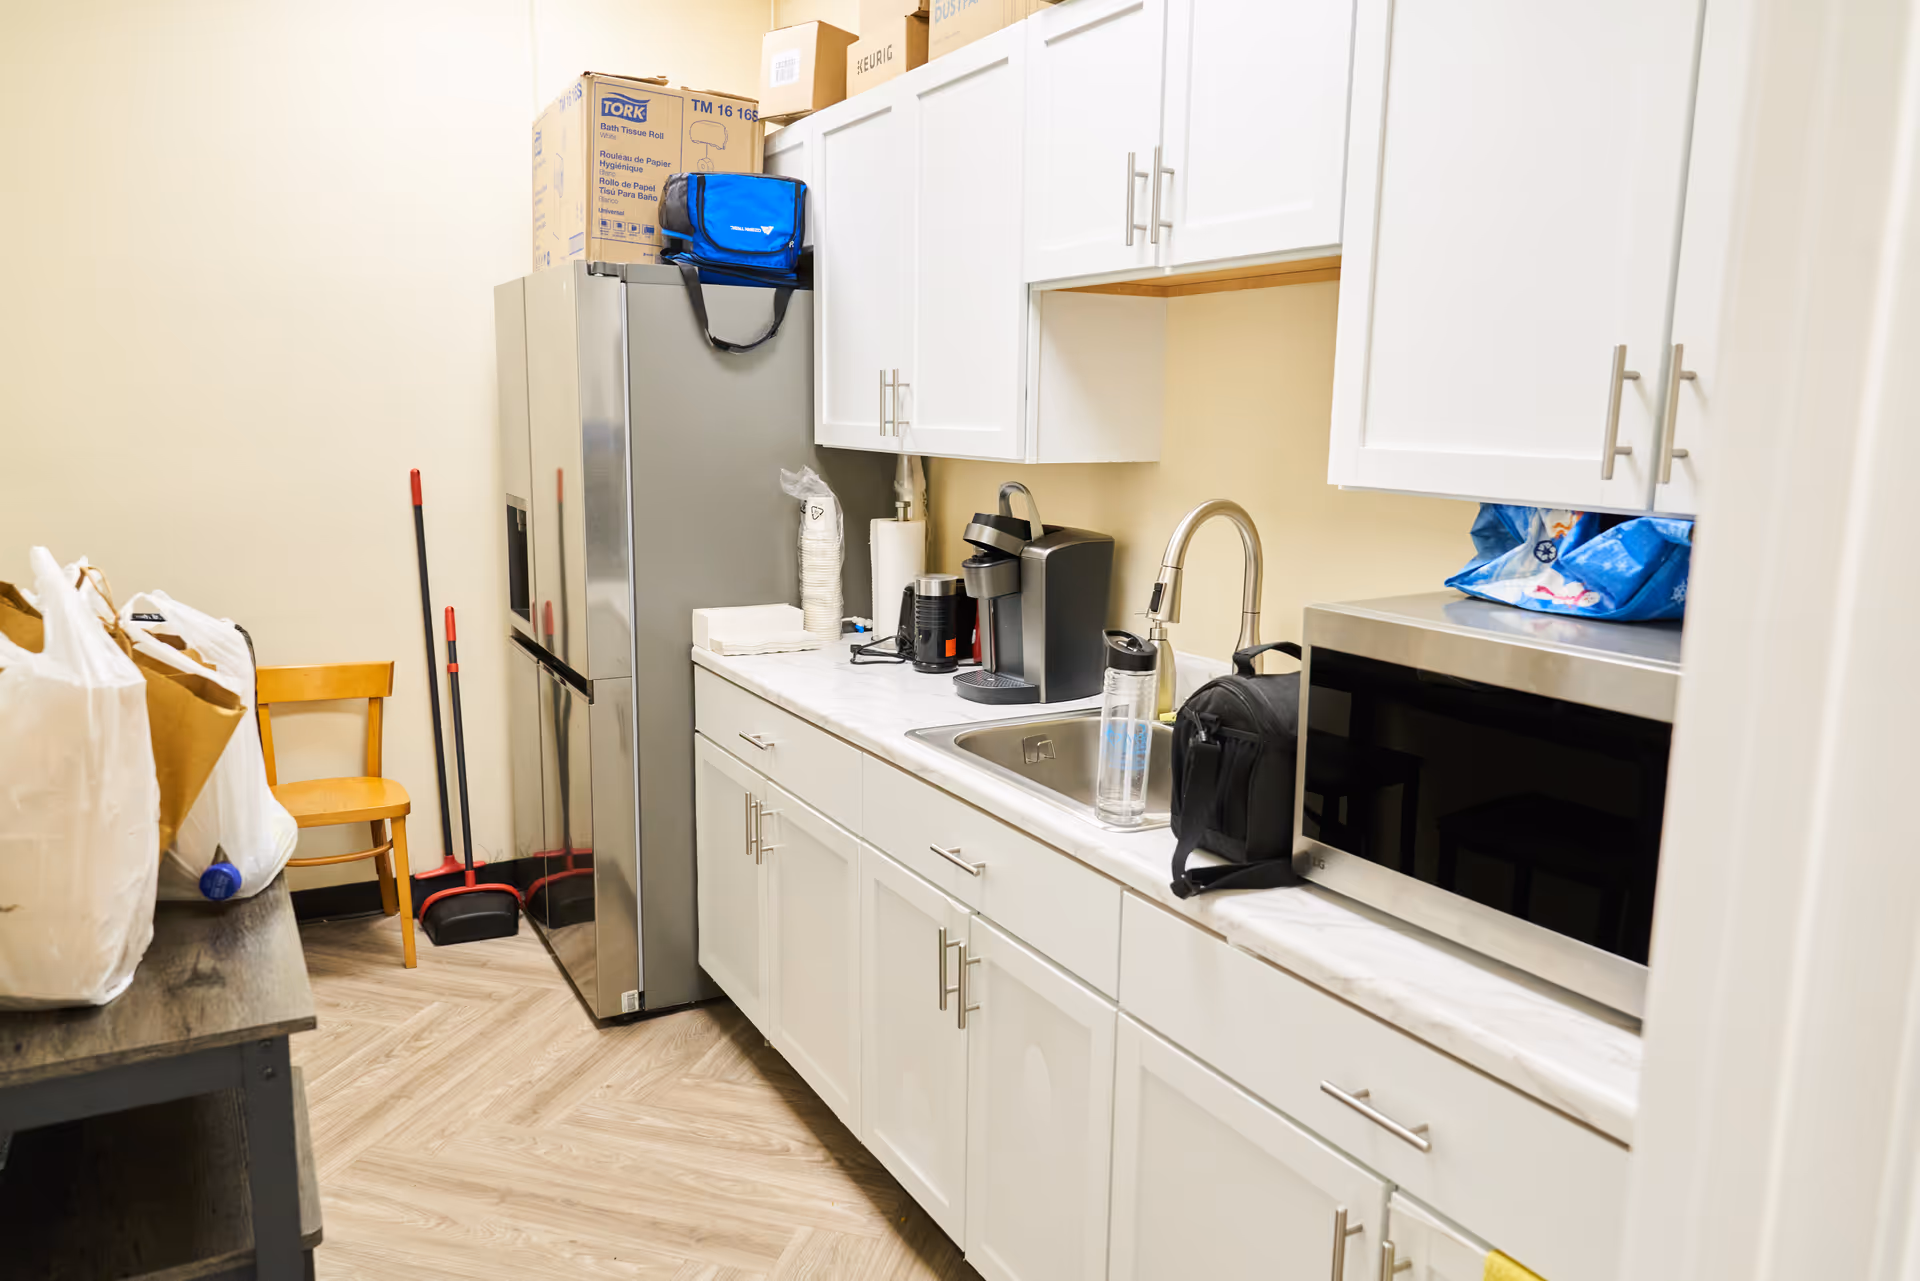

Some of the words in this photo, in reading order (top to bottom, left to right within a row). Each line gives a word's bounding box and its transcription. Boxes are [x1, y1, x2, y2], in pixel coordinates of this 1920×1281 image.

[936, 0, 979, 23] DUSTPA
[857, 44, 893, 75] KEURIG
[603, 100, 645, 120] TORK
[691, 99, 713, 114] TM
[718, 104, 733, 117] 16
[737, 108, 759, 122] 16S
[600, 122, 620, 133] Bath
[621, 126, 647, 137] Tissue
[649, 130, 664, 140] Roll
[599, 150, 633, 162] Rouleau
[634, 156, 645, 164] de
[646, 157, 672, 168] Papier
[599, 159, 644, 173] Hygiénique
[599, 177, 620, 187] Rollo
[633, 182, 656, 192] Papel
[599, 186, 616, 196] Tisú
[617, 189, 636, 198] Para
[637, 192, 658, 202] Baño
[598, 207, 625, 216] Universal
[1313, 856, 1325, 870] LG
